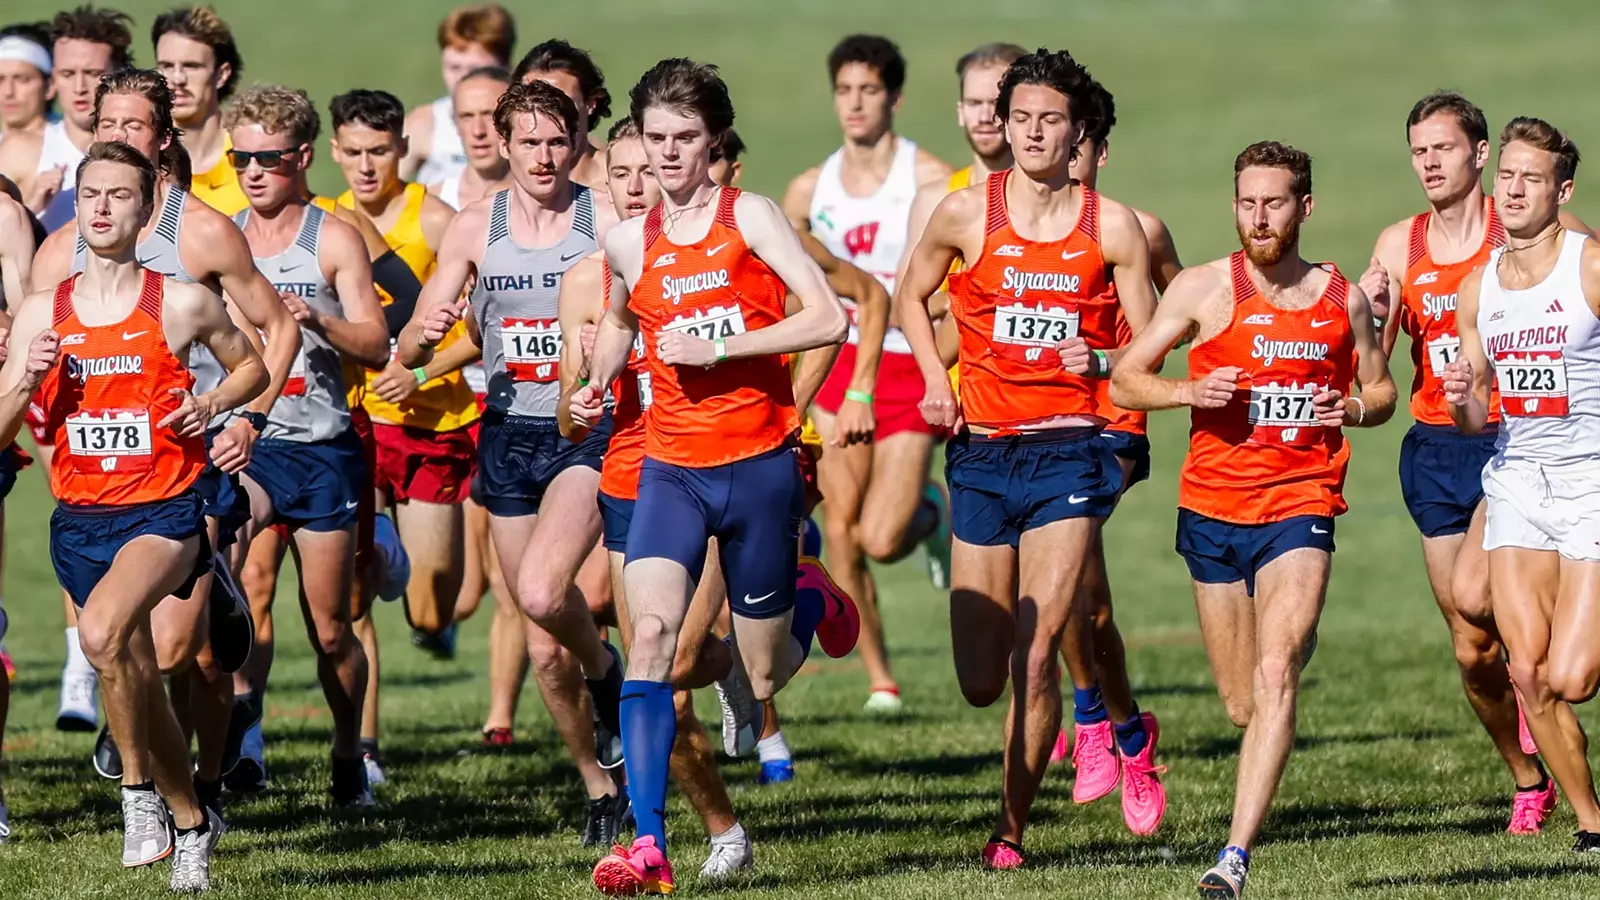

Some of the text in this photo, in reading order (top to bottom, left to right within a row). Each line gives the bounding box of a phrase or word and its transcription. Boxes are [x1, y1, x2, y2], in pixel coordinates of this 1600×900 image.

[843, 221, 880, 258] W
[993, 244, 1024, 257] ACC
[652, 252, 677, 268] ACC
[483, 275, 533, 292] UTAH
[662, 268, 730, 305] Syracuse
[1001, 265, 1080, 298] Syracuse
[1412, 271, 1439, 286] ACC
[1241, 314, 1274, 325] ACC
[1489, 310, 1506, 322] ACC
[60, 333, 87, 346] ACC
[1006, 316, 1068, 342] 1373
[1487, 325, 1569, 356] WOLFPACK
[1250, 334, 1329, 367] Syracuse
[67, 353, 143, 386] Syracuse
[1505, 367, 1556, 391] 1223
[76, 425, 140, 450] 1378
